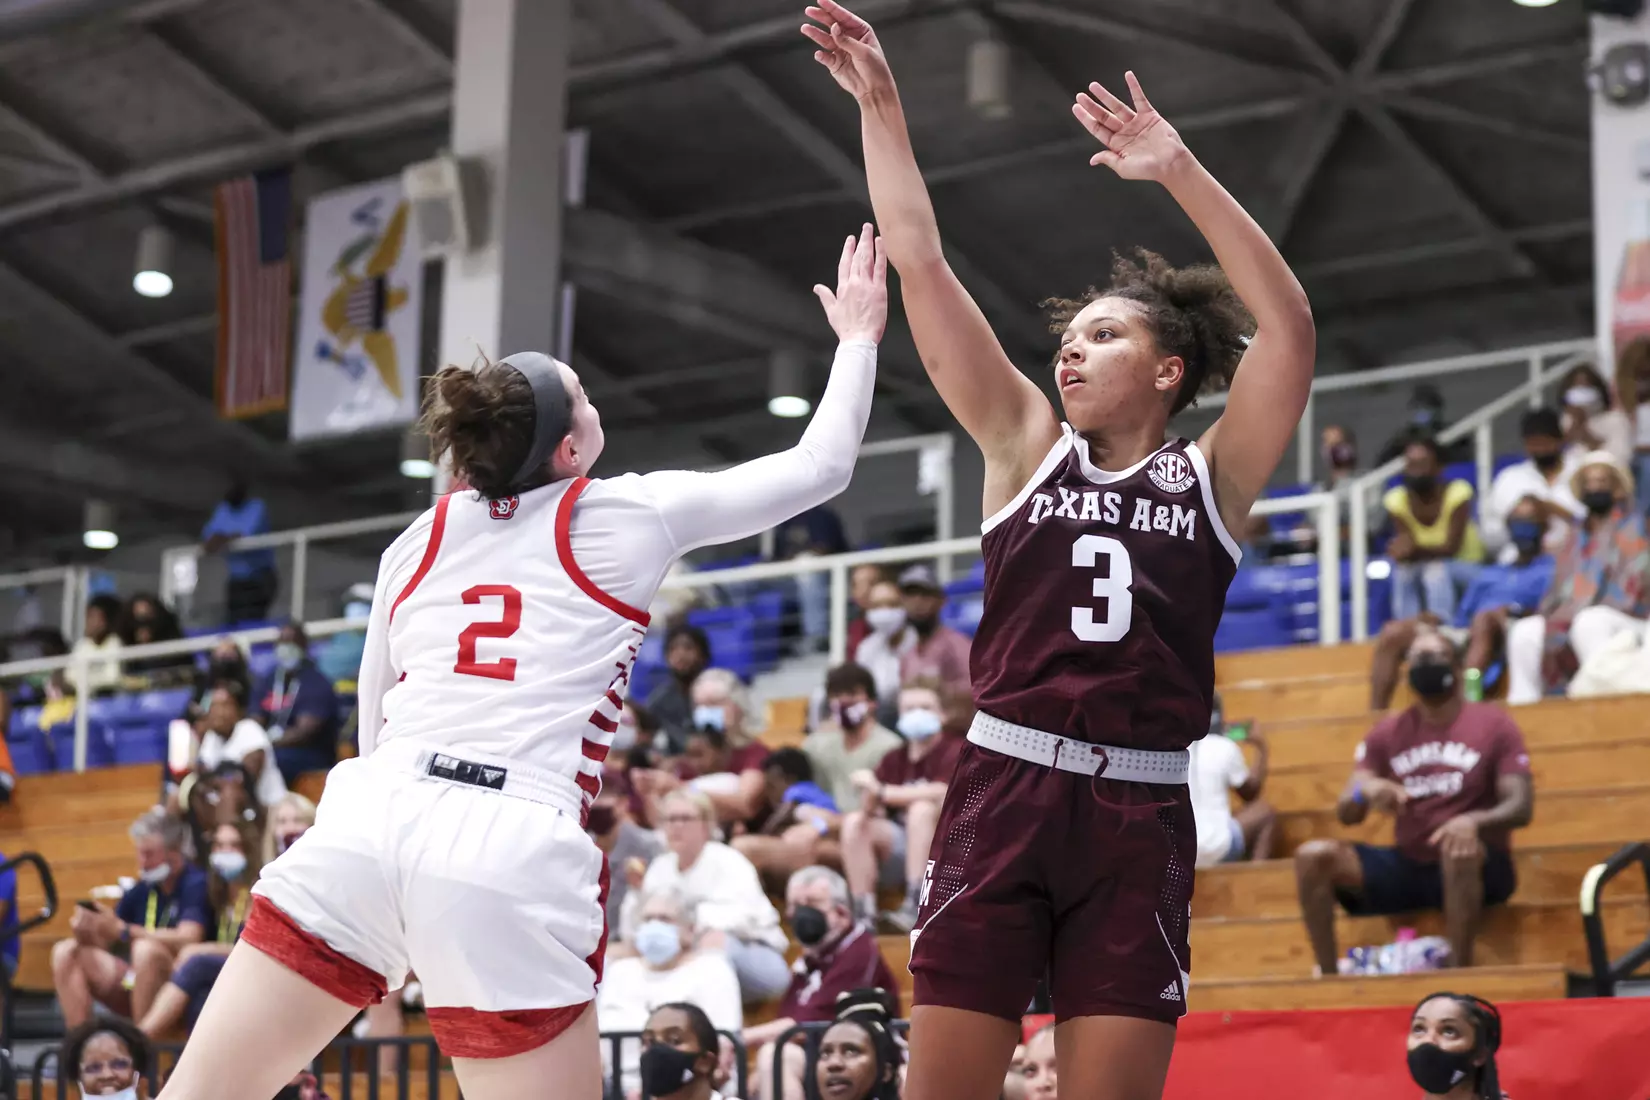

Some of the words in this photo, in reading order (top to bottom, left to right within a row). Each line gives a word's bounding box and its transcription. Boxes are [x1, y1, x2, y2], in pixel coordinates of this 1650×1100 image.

[1151, 475, 1189, 492] GRADUATE
[1155, 454, 1186, 483] SEC
[1129, 497, 1197, 541] A&M
[1071, 534, 1133, 642] 3
[453, 584, 522, 681] 2
[1160, 992, 1181, 1001] adidas
